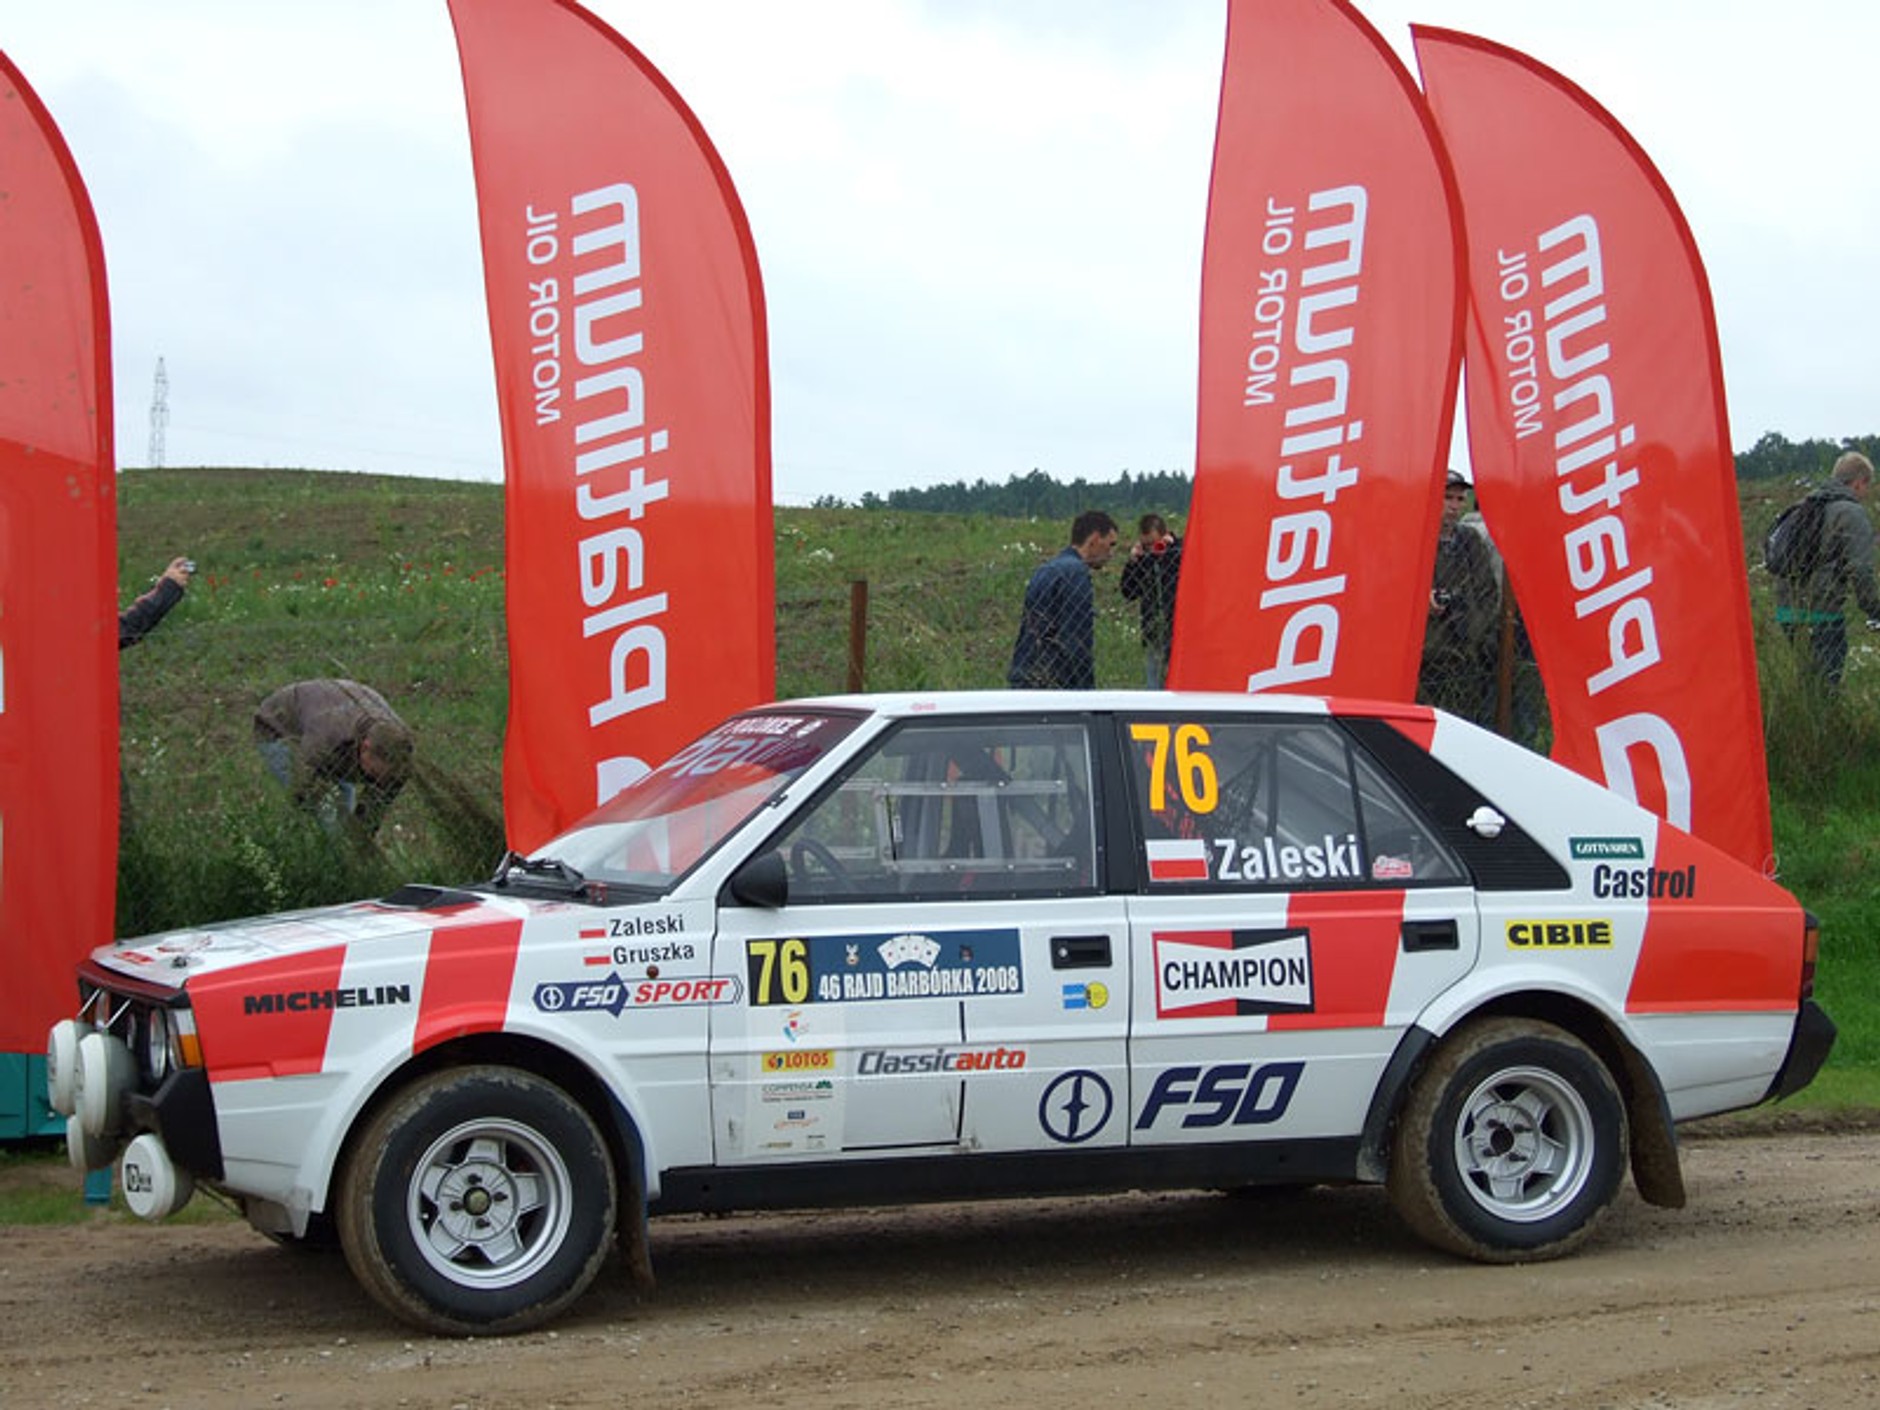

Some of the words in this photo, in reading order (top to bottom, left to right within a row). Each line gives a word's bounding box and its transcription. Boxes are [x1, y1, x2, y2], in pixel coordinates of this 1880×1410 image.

[1130, 724, 1219, 814] 76
[1213, 834, 1362, 882] Zaleski
[1593, 863, 1696, 900] Castrol
[609, 914, 686, 937] Zaleski
[612, 943, 696, 965] Gruszka
[749, 940, 809, 1004] 76
[818, 976, 841, 1001] 46
[844, 973, 884, 998] RAJD
[976, 966, 1019, 991] 2008
[1162, 955, 1306, 990] CHAMPION
[243, 985, 411, 1015] MICHELIN
[571, 986, 621, 1007] FSO
[634, 980, 730, 1004] SPORT
[786, 1051, 829, 1068] LOTOS
[1135, 1062, 1305, 1130] FSO
